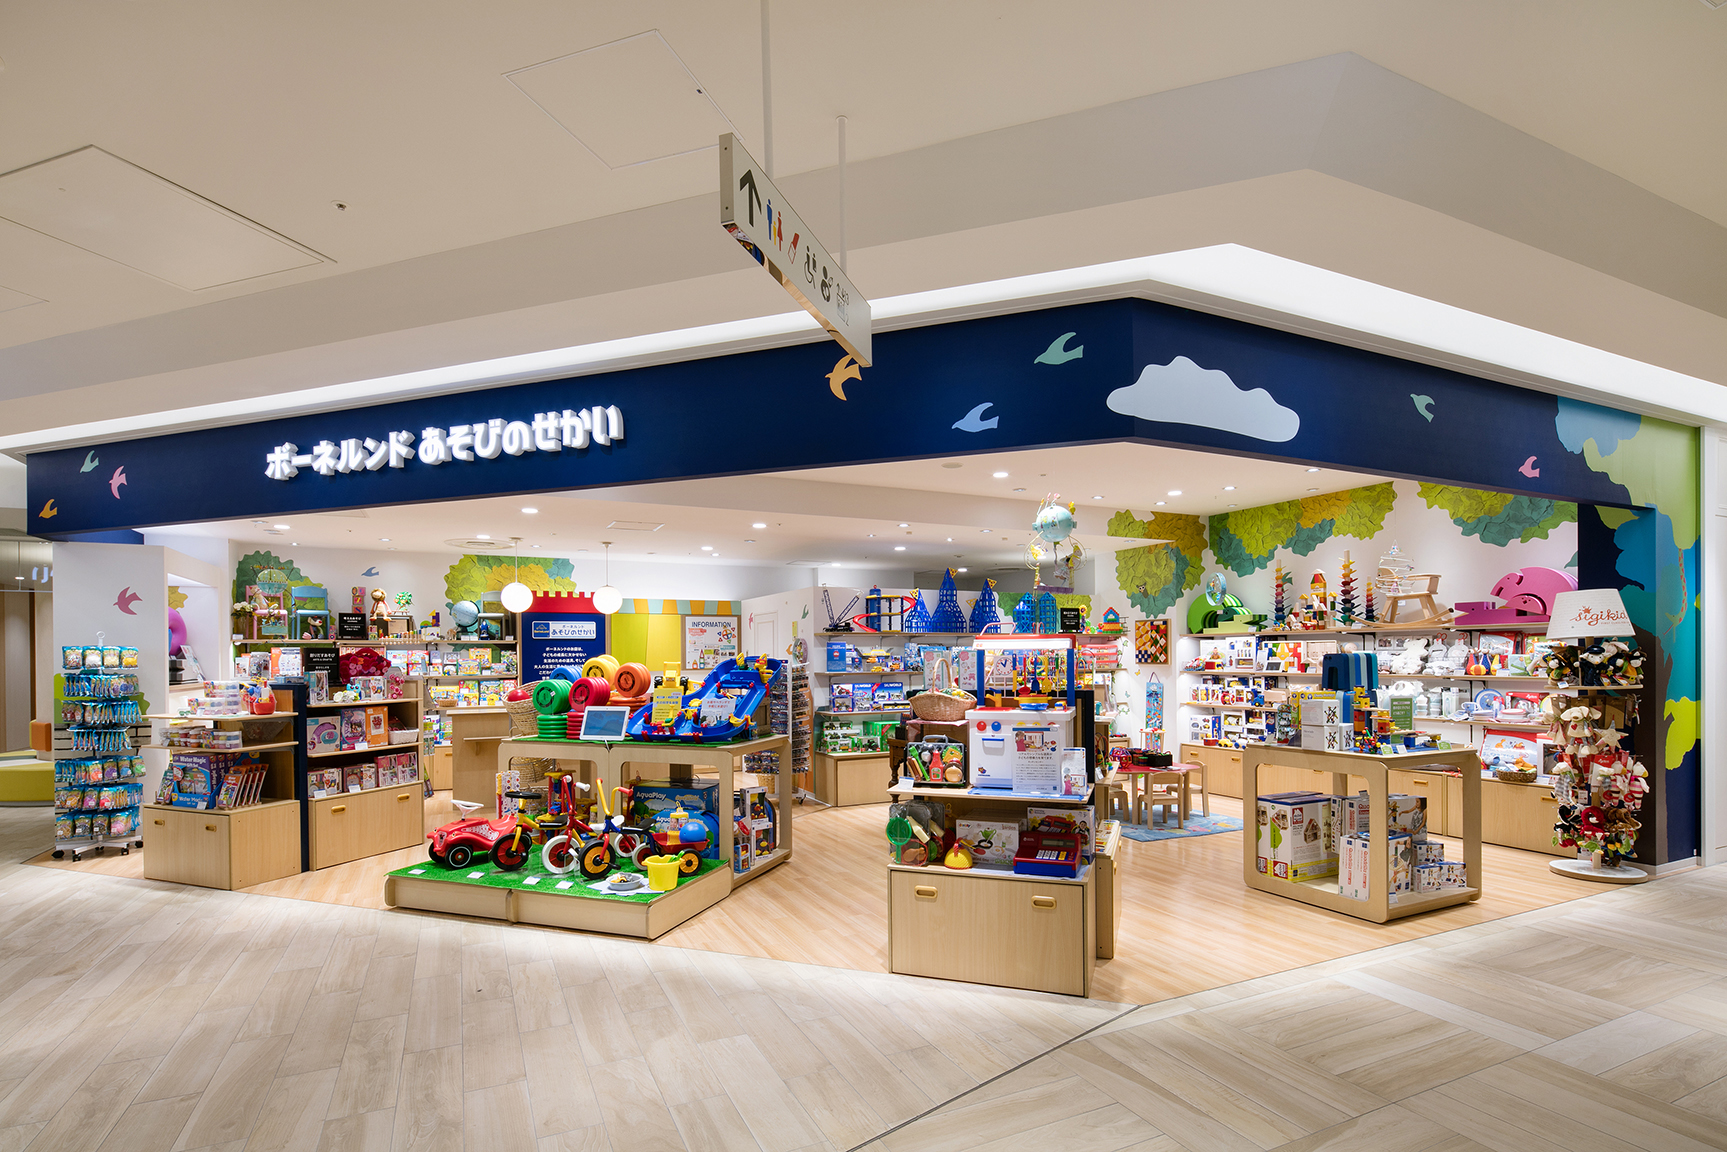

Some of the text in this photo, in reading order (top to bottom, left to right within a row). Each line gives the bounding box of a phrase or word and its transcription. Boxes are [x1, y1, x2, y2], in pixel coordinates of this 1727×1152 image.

[265, 404, 624, 481] ボーネルンド あそびのせかい
[1569, 608, 1628, 627] sigikid
[192, 756, 206, 764] Magic
[636, 791, 666, 800] AquaPlay
